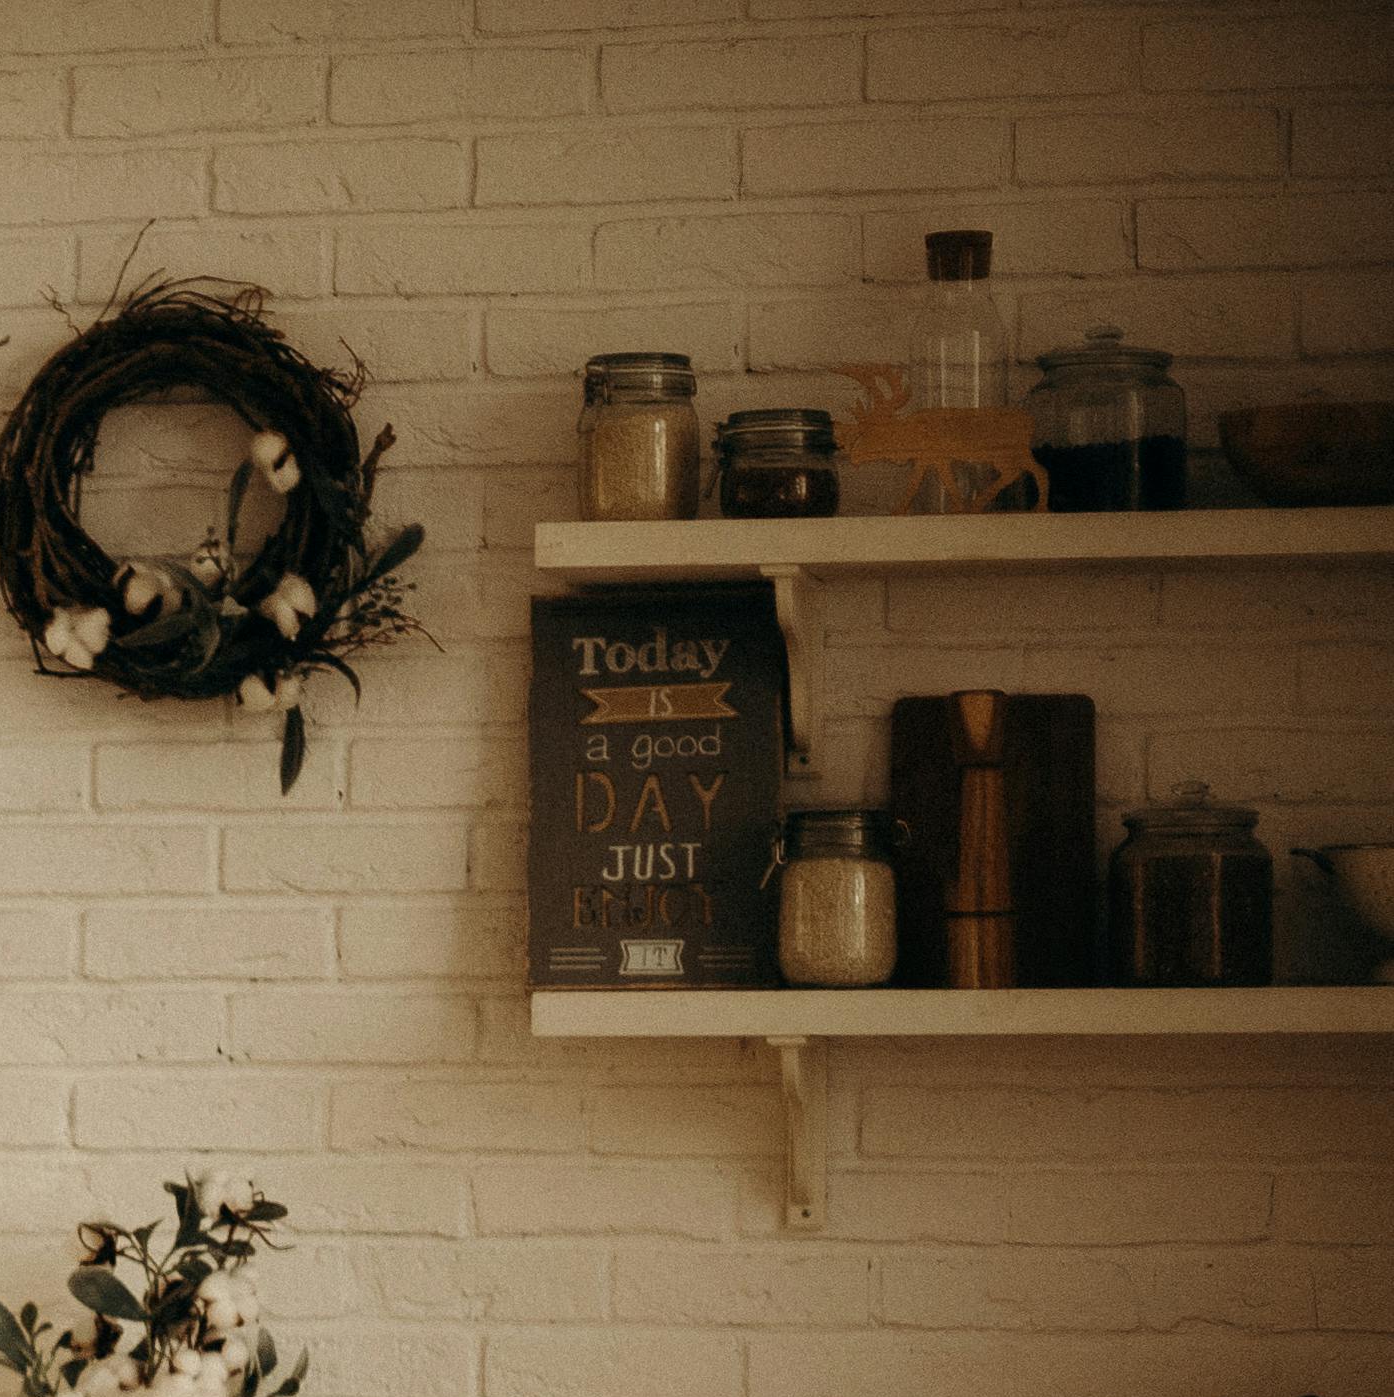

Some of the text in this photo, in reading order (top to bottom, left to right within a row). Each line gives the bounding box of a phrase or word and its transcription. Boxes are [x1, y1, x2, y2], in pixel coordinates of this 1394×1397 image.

[572, 627, 729, 677] Today
[649, 689, 674, 717] IS
[586, 725, 721, 769] a good
[574, 772, 727, 832] DAY
[602, 843, 701, 881] JUST
[641, 946, 668, 967] IT
